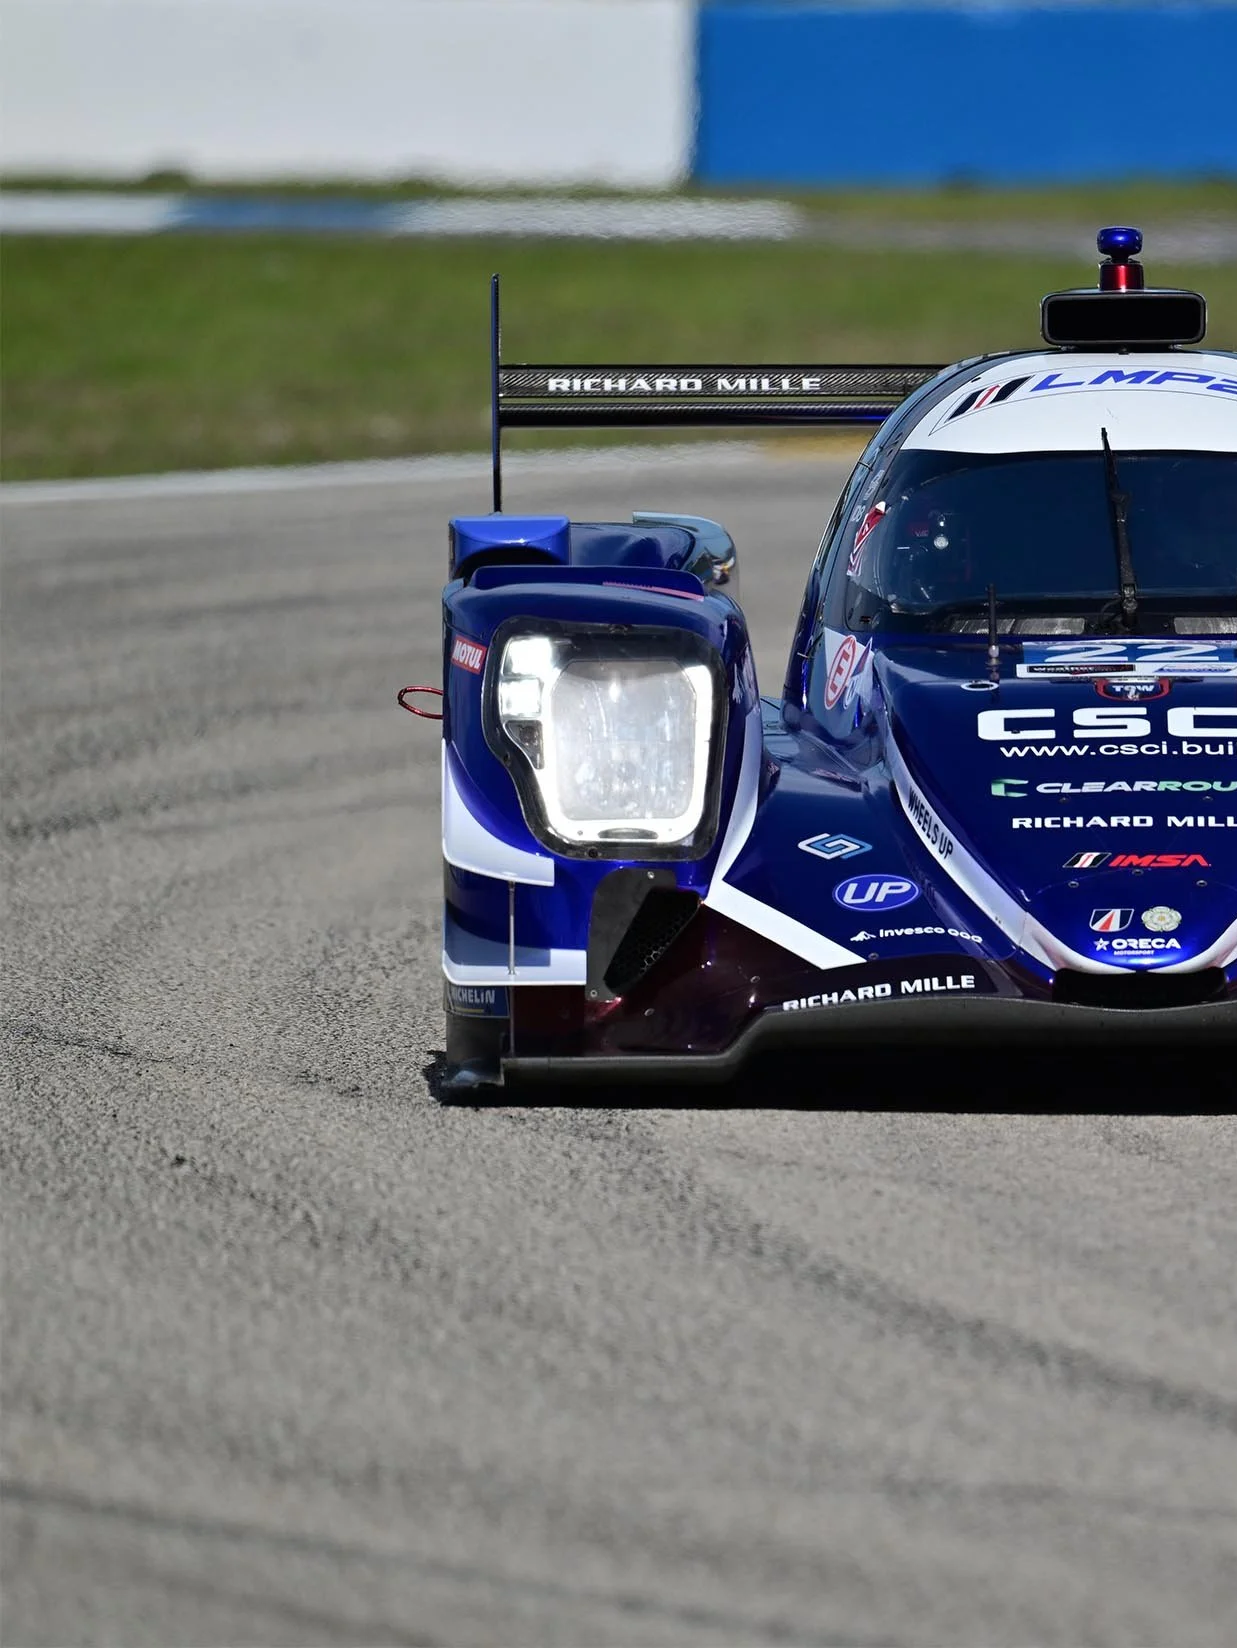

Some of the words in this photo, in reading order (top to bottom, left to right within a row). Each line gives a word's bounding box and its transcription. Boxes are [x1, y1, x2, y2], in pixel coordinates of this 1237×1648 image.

[548, 378, 702, 391] RICHARD
[717, 378, 821, 391] MILLE
[452, 640, 483, 669] MOTUL
[1044, 644, 1220, 662] 22
[908, 786, 940, 846] WHEELS
[938, 832, 954, 860] UP
[1012, 816, 1153, 829] RICHARD
[1108, 854, 1207, 868] IMSA
[843, 882, 912, 904] UP
[879, 926, 945, 938] Invesco
[947, 928, 983, 943] QQQ
[1111, 938, 1182, 949] ORECA
[782, 982, 892, 1011] RICHARD
[900, 975, 976, 994] MILLE
